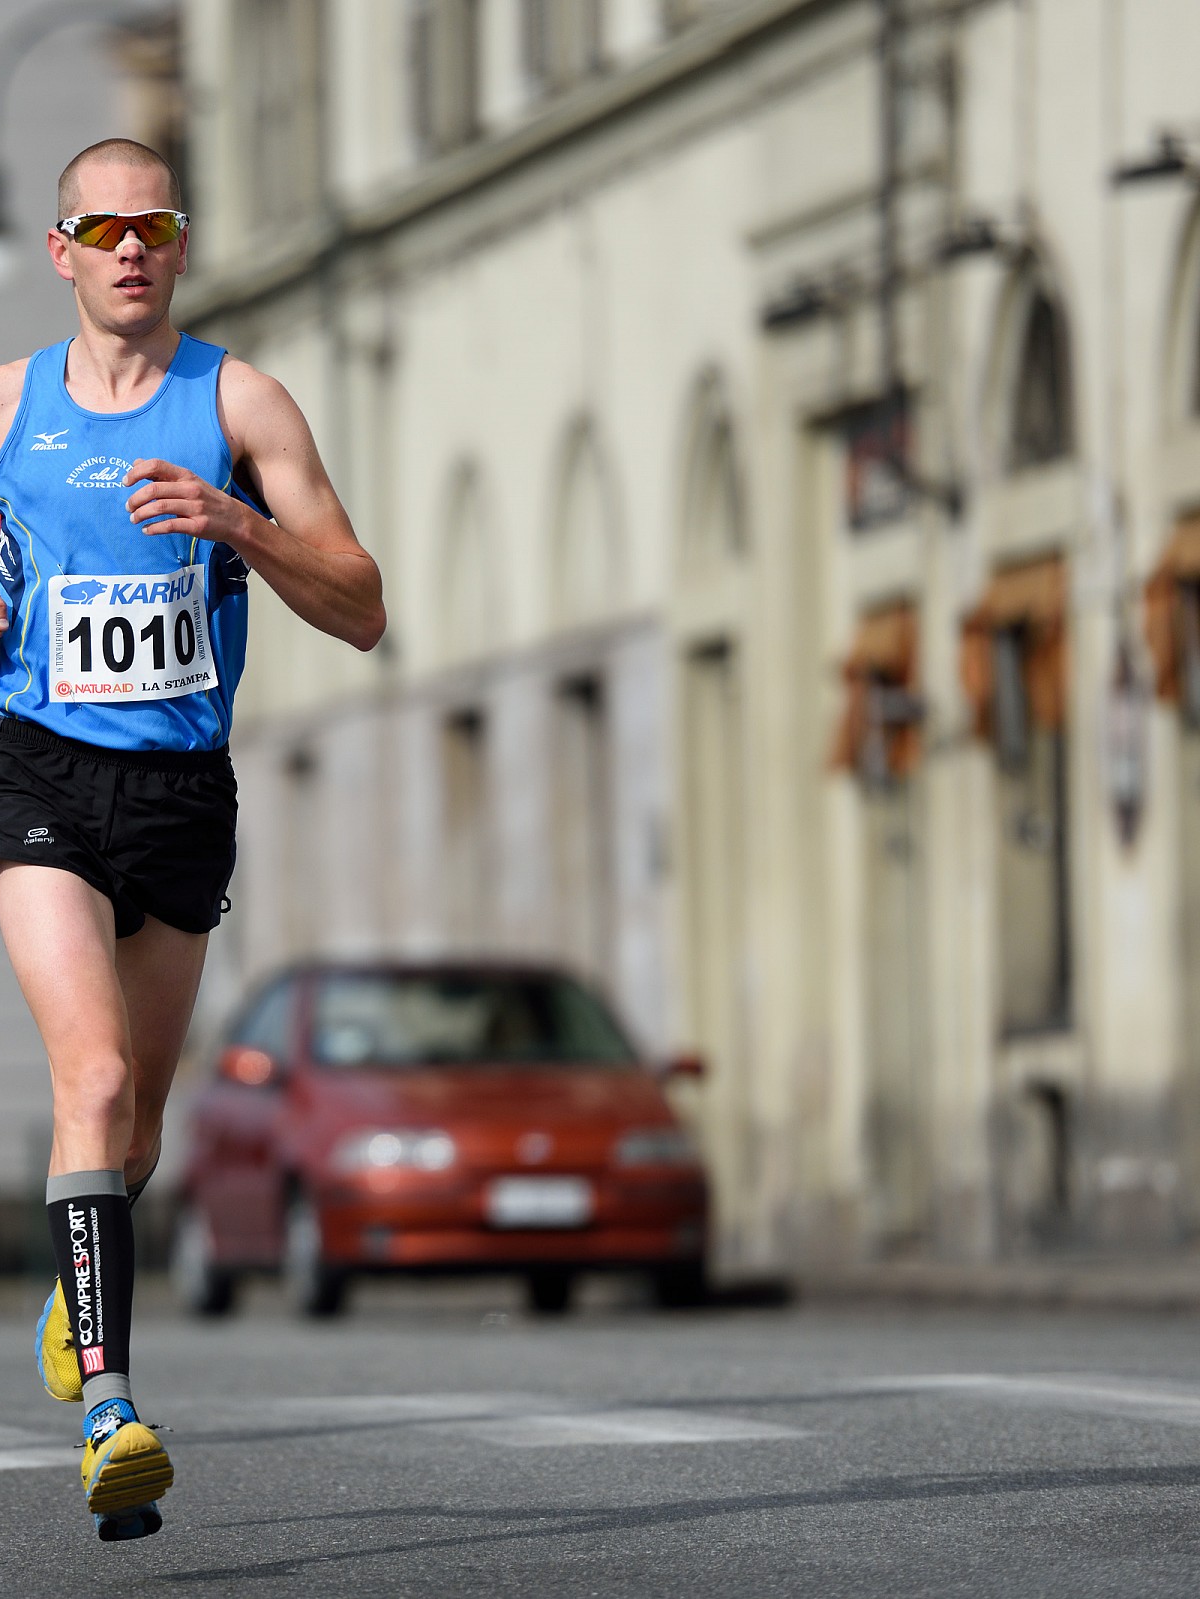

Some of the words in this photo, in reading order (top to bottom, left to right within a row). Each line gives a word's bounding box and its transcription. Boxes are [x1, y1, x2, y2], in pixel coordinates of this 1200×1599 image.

[65, 456, 106, 485] RUNNING
[109, 457, 134, 473] CENT
[89, 466, 120, 481] club
[109, 573, 195, 605] KARHU
[68, 609, 196, 673] 1010
[141, 682, 160, 692] LA
[164, 672, 211, 690] STAMPA
[90, 1207, 100, 1244] TECHNOLOGY
